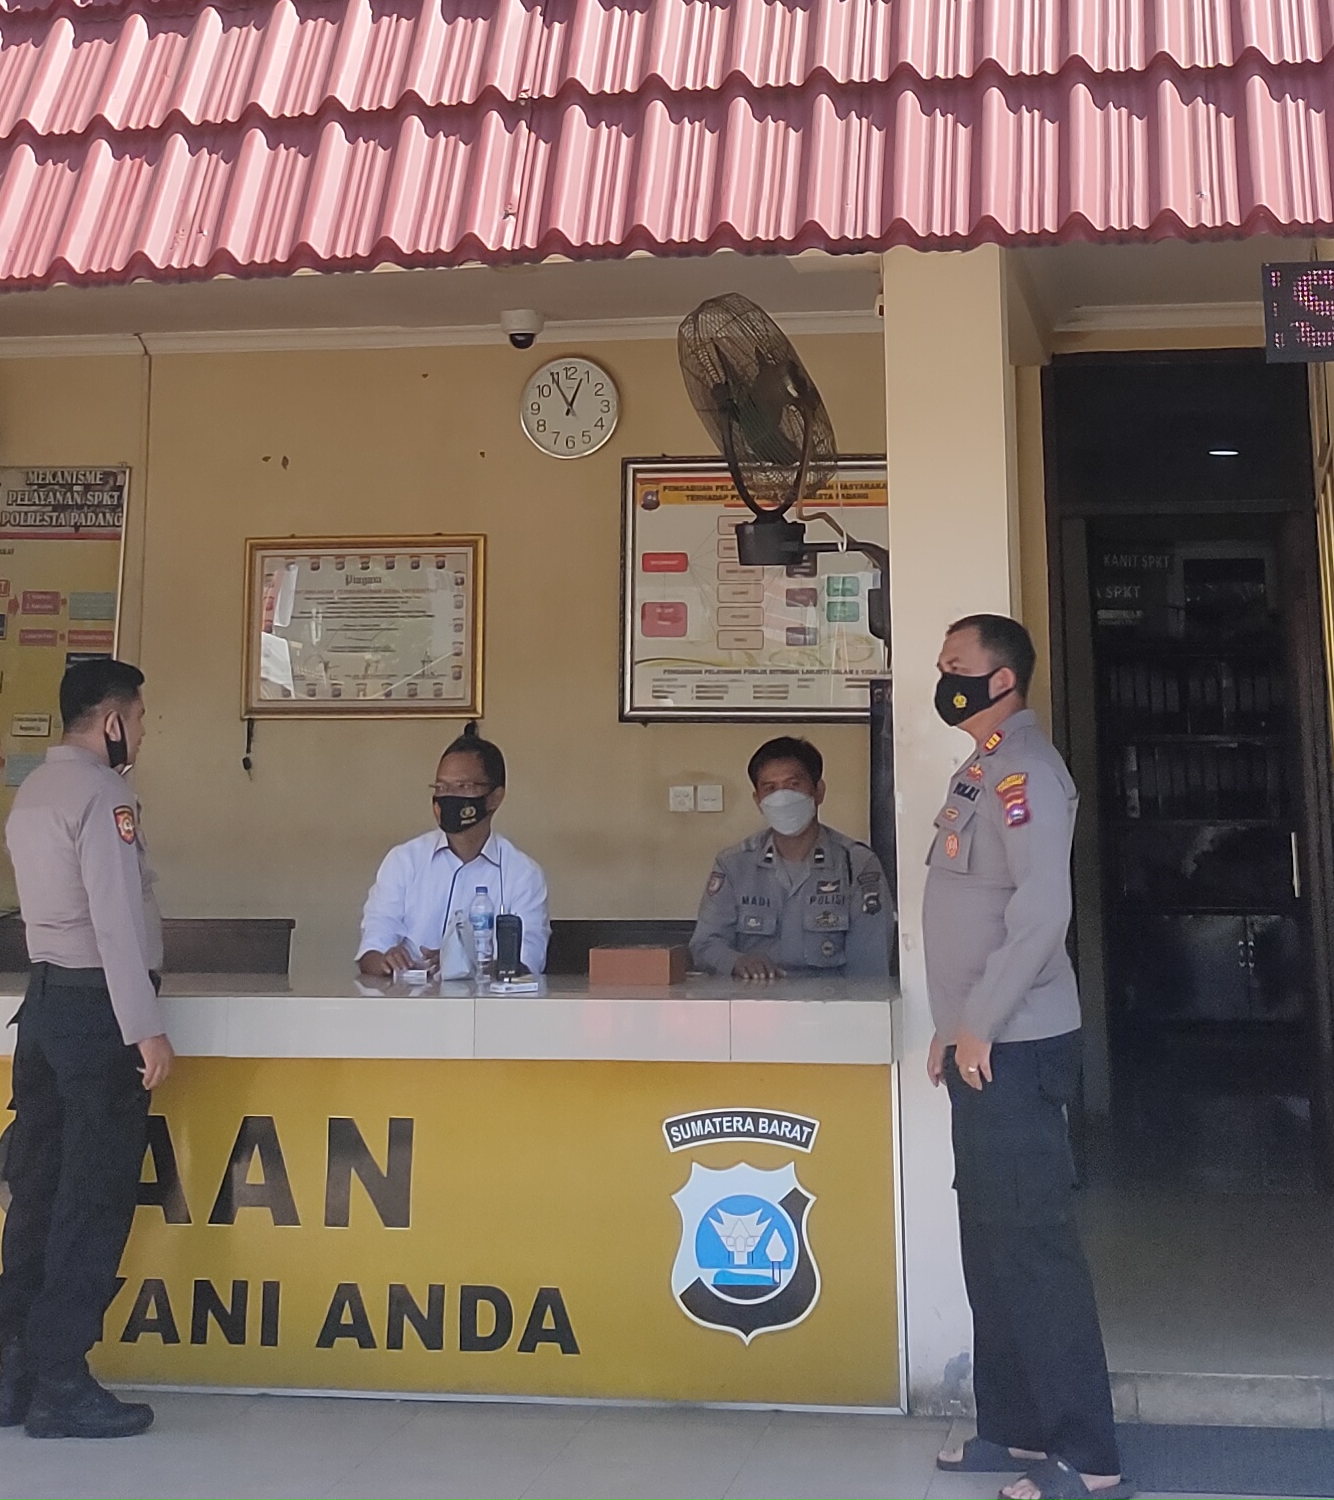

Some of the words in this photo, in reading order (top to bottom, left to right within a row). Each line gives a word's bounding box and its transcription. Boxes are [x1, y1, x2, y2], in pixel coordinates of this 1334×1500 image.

[563, 366, 578, 380] 12
[584, 370, 590, 384] 1
[536, 384, 552, 398] 10
[594, 382, 605, 396] 2
[530, 401, 541, 415] 9
[600, 400, 611, 413] 3
[536, 419, 546, 432] 8
[593, 416, 605, 430] 4
[552, 431, 560, 445] 7
[565, 435, 576, 449] 6
[581, 430, 591, 444] 5
[26, 470, 105, 486] MEKANISME
[7, 490, 82, 506] PELAYANAN
[85, 490, 120, 506] SPKT
[0, 511, 66, 527] POLRESTA
[69, 511, 123, 527] PADANG
[669, 1116, 756, 1143] SUMATERA
[758, 1117, 813, 1143] BARAT
[314, 1280, 581, 1357] ANDA
